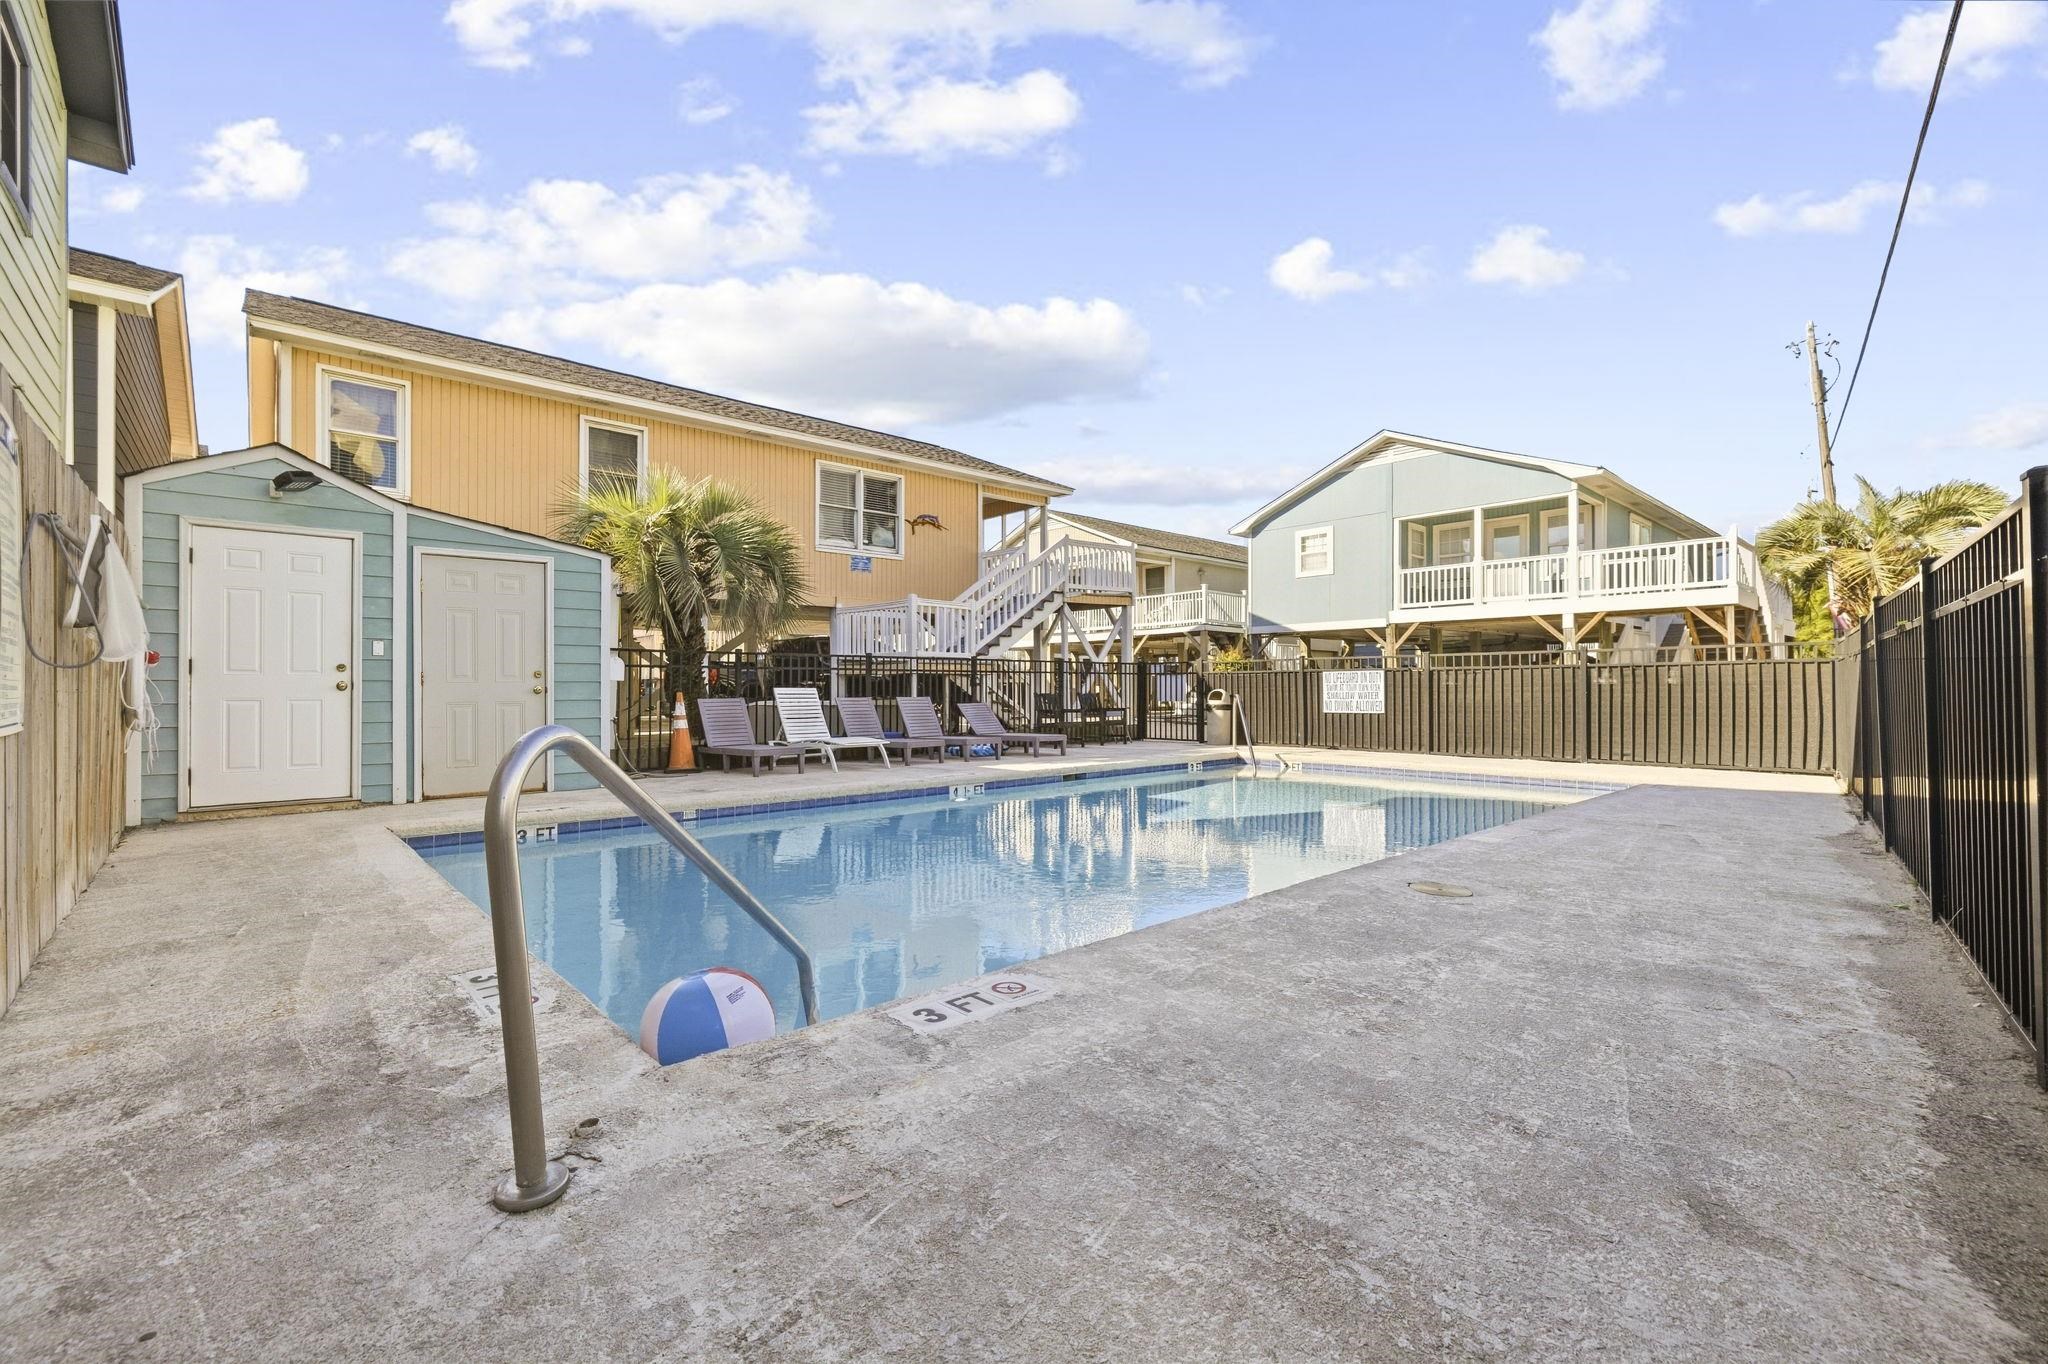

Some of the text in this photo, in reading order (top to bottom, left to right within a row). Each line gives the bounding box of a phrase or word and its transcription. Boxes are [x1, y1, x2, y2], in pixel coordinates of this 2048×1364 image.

[1325, 700, 1383, 711] NO DIVING ALLOWED
[912, 1008, 947, 1023] 3
[945, 991, 994, 1013] FT
